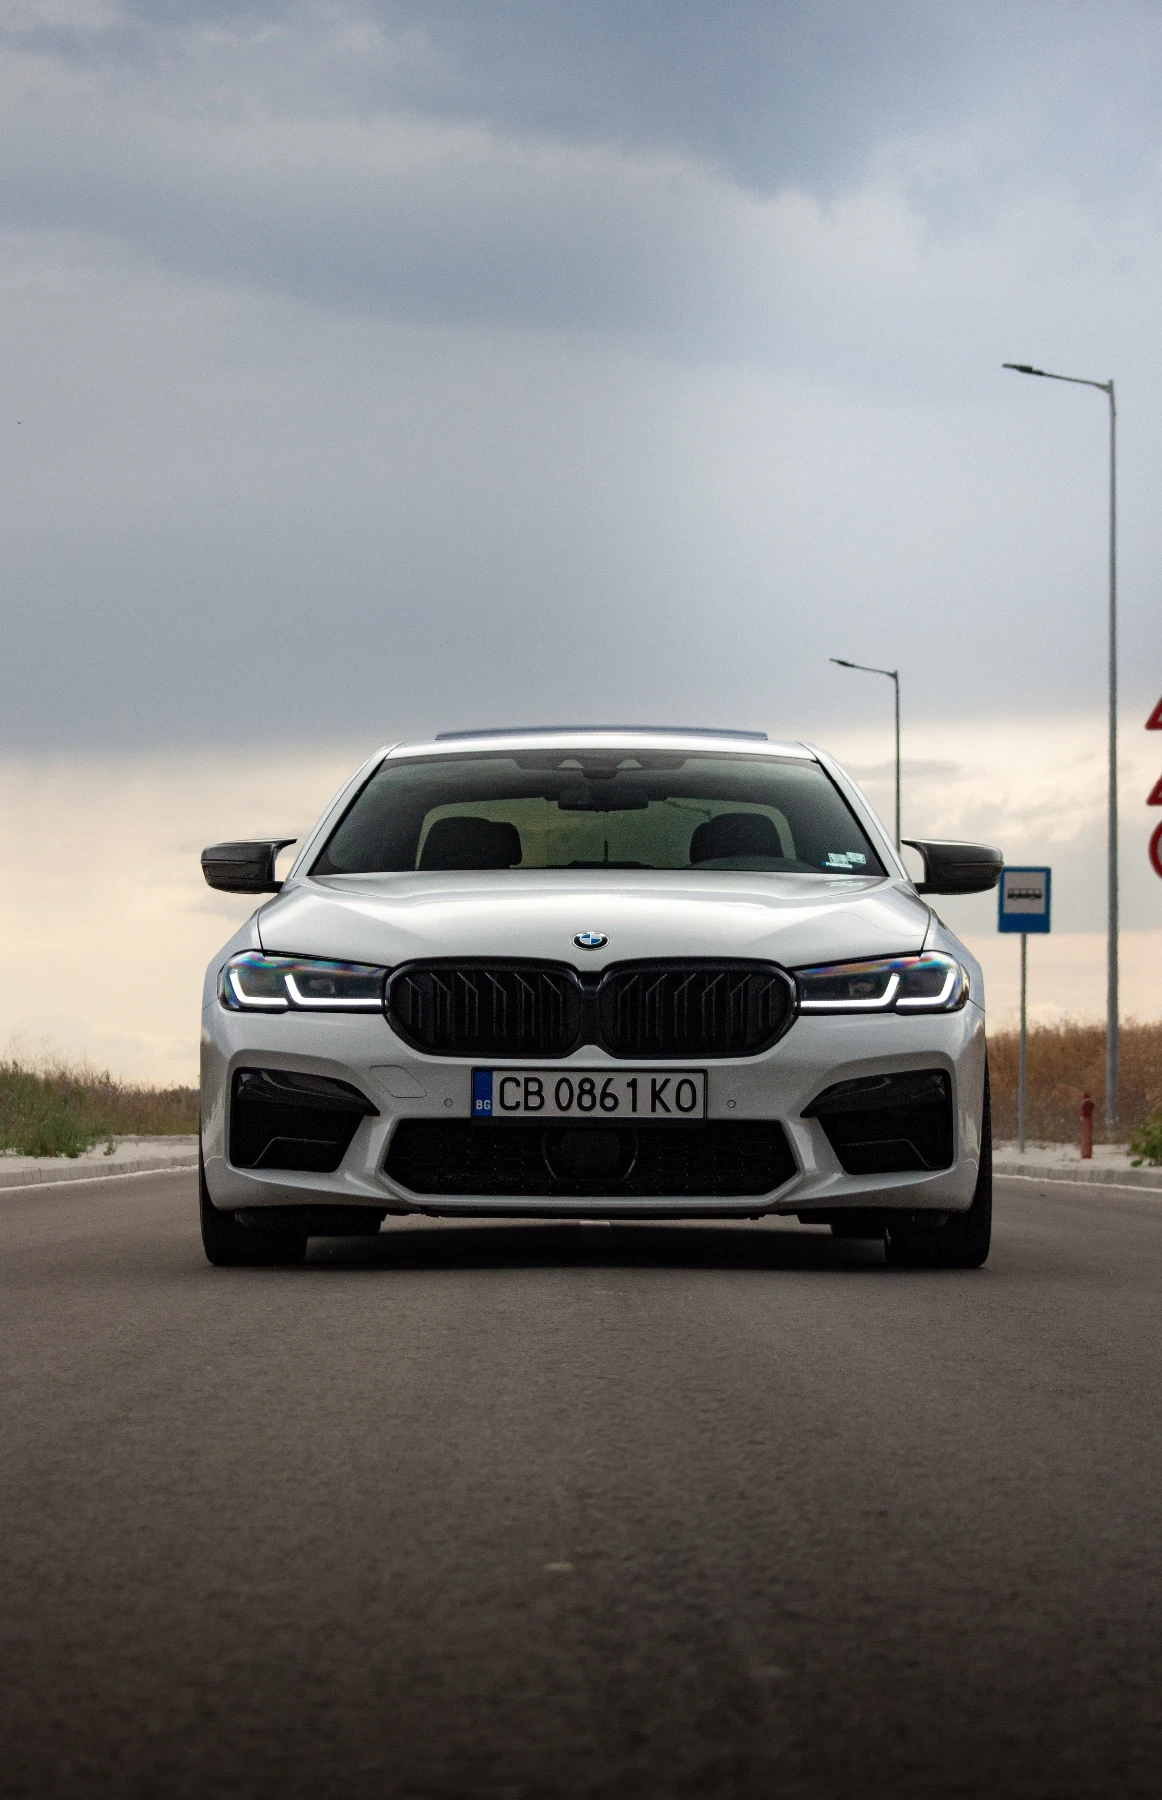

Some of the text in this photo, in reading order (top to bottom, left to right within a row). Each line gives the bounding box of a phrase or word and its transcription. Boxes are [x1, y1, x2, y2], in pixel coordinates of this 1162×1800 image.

[476, 1099, 491, 1110] BG
[499, 1076, 697, 1113] CB 0861 KO
